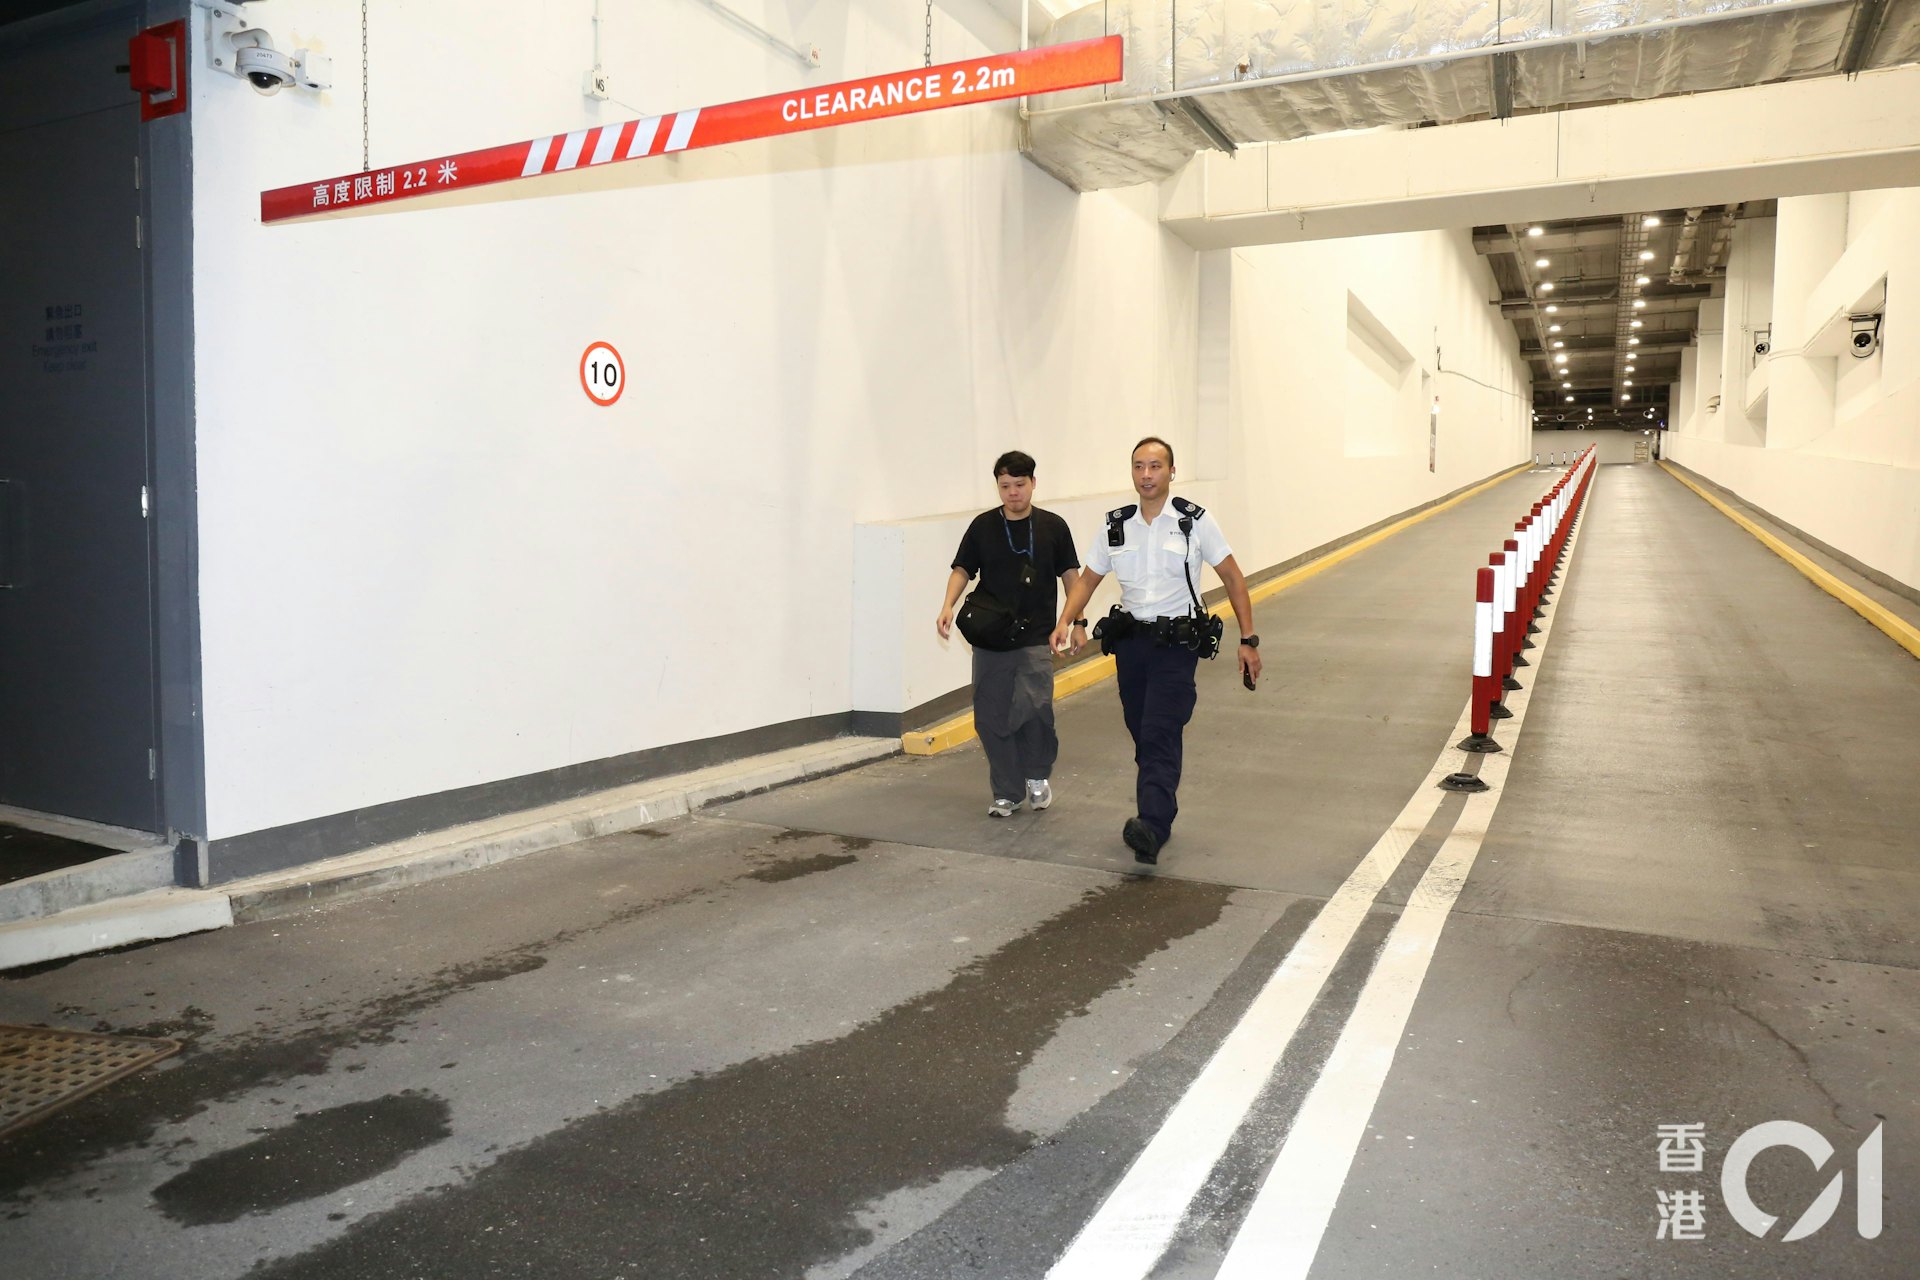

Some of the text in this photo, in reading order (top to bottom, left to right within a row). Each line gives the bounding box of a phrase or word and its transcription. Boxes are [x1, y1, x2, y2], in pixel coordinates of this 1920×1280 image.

[782, 66, 1016, 122] CLEARANCE 2.2m
[312, 160, 458, 207] 高度限制 2.2 米
[591, 361, 617, 387] 10
